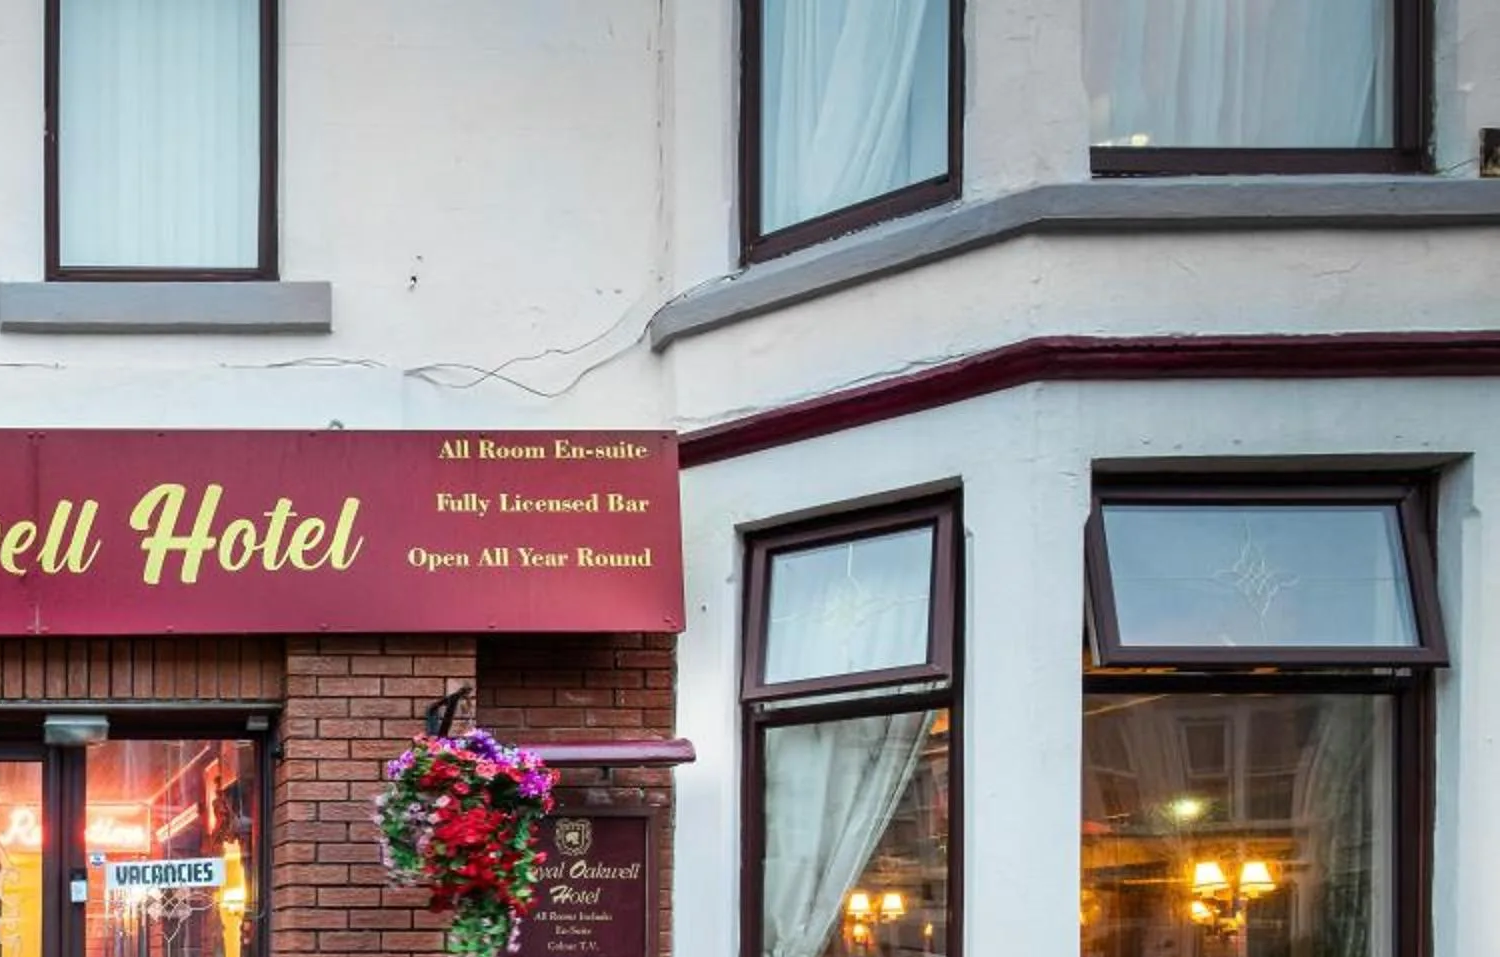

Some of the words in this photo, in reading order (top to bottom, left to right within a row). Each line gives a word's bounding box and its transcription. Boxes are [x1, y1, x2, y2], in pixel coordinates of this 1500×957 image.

[438, 439, 470, 459] All
[479, 439, 546, 459] Room
[554, 439, 648, 459] En-suite
[436, 493, 490, 517] Fully
[499, 493, 599, 513] Licensed
[607, 493, 650, 513] Bar
[129, 483, 364, 585] Hotel
[407, 547, 470, 571] Open
[478, 547, 509, 567] All
[517, 547, 569, 567] Year
[576, 547, 652, 567] Round
[115, 862, 213, 885] VACANCIES
[569, 860, 641, 880] Oakwell
[549, 884, 601, 905] Hotel
